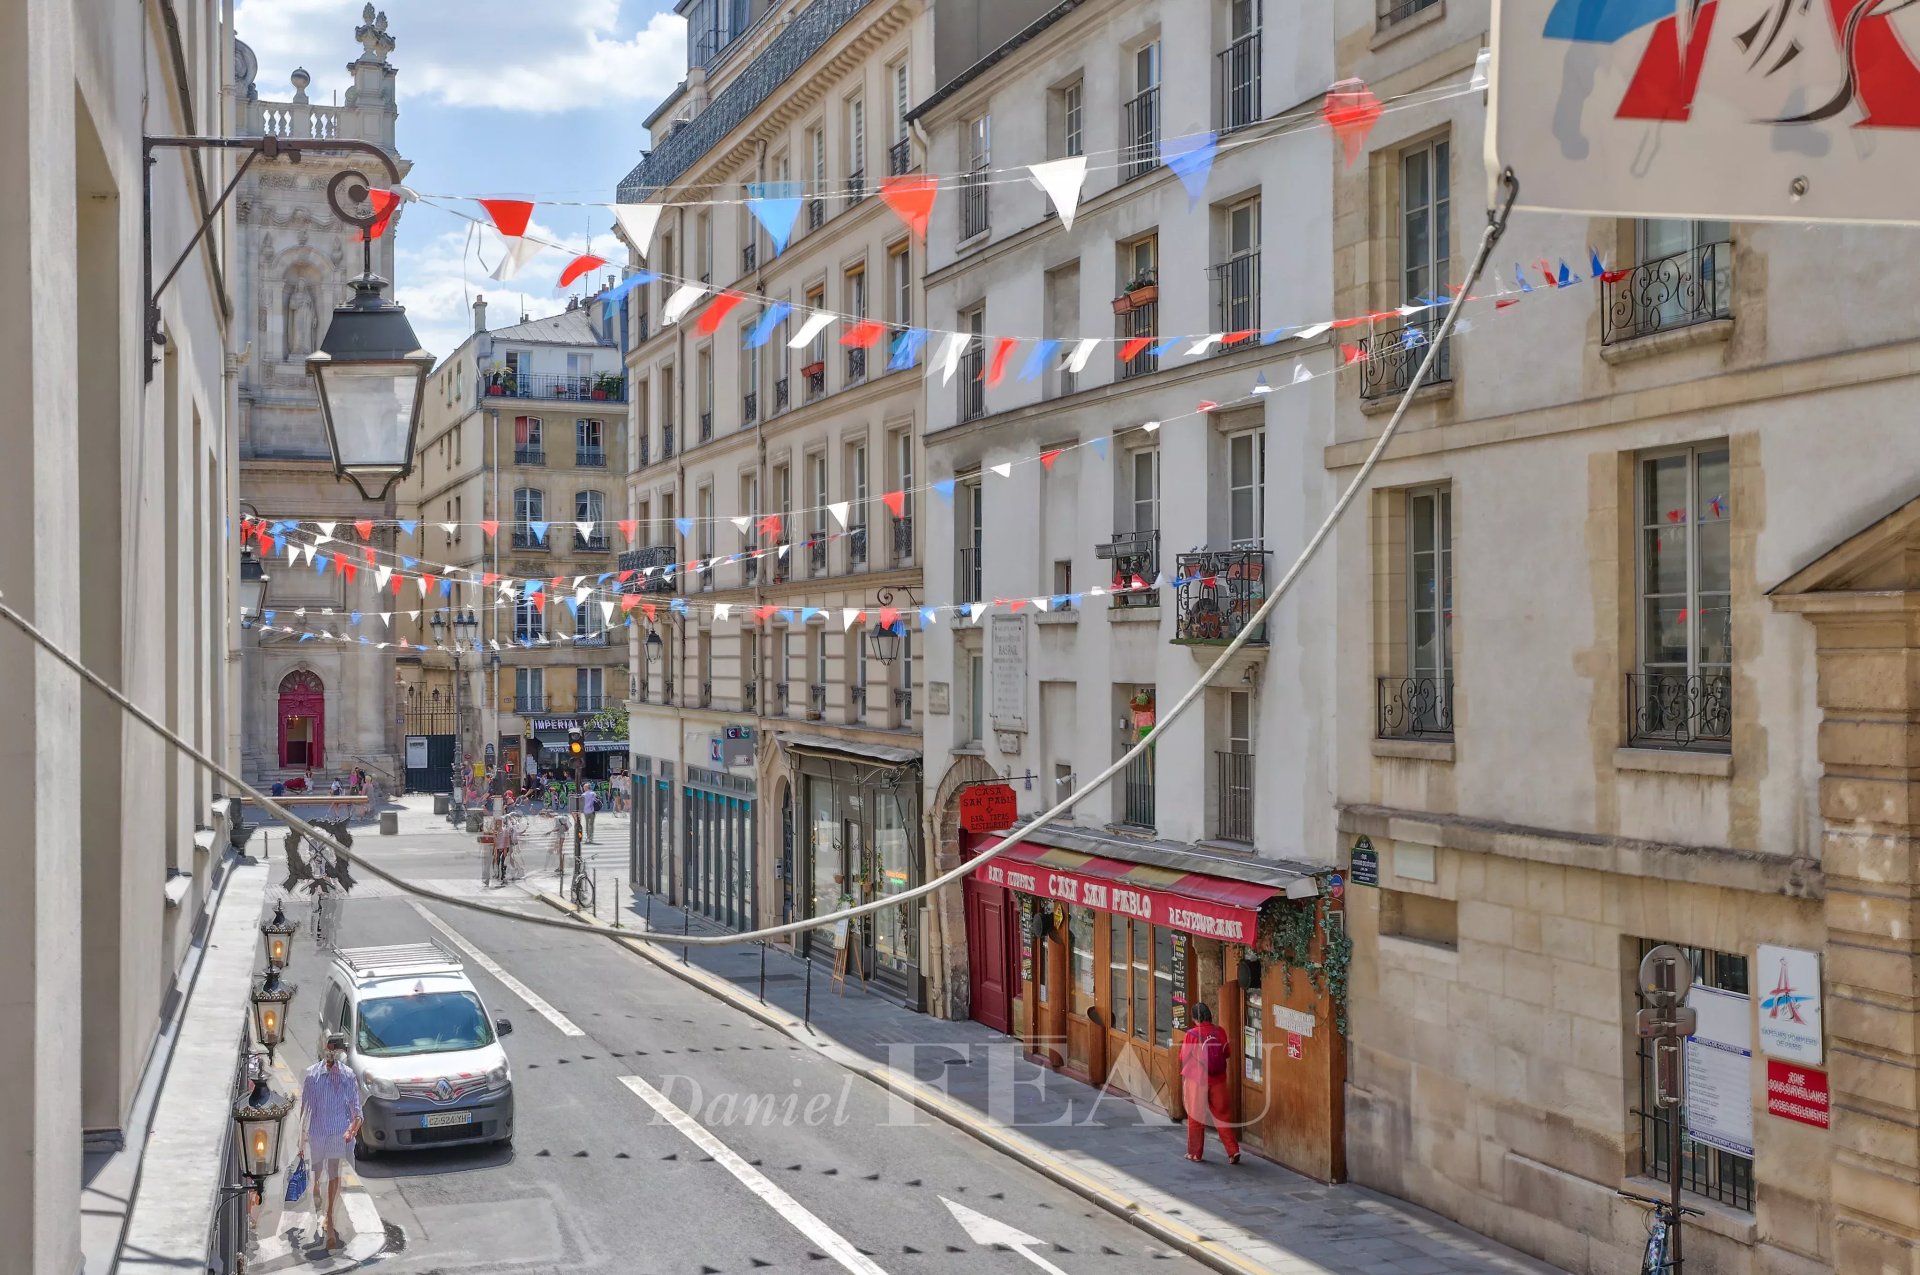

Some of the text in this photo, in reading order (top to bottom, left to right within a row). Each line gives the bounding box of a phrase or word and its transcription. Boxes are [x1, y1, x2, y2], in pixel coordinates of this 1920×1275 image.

[975, 787, 1002, 796] CASA
[963, 798, 982, 807] SAN
[988, 865, 1004, 884] BAR
[1048, 874, 1152, 919] CASA SAN PABLO
[1168, 906, 1244, 939] RESTAURANT
